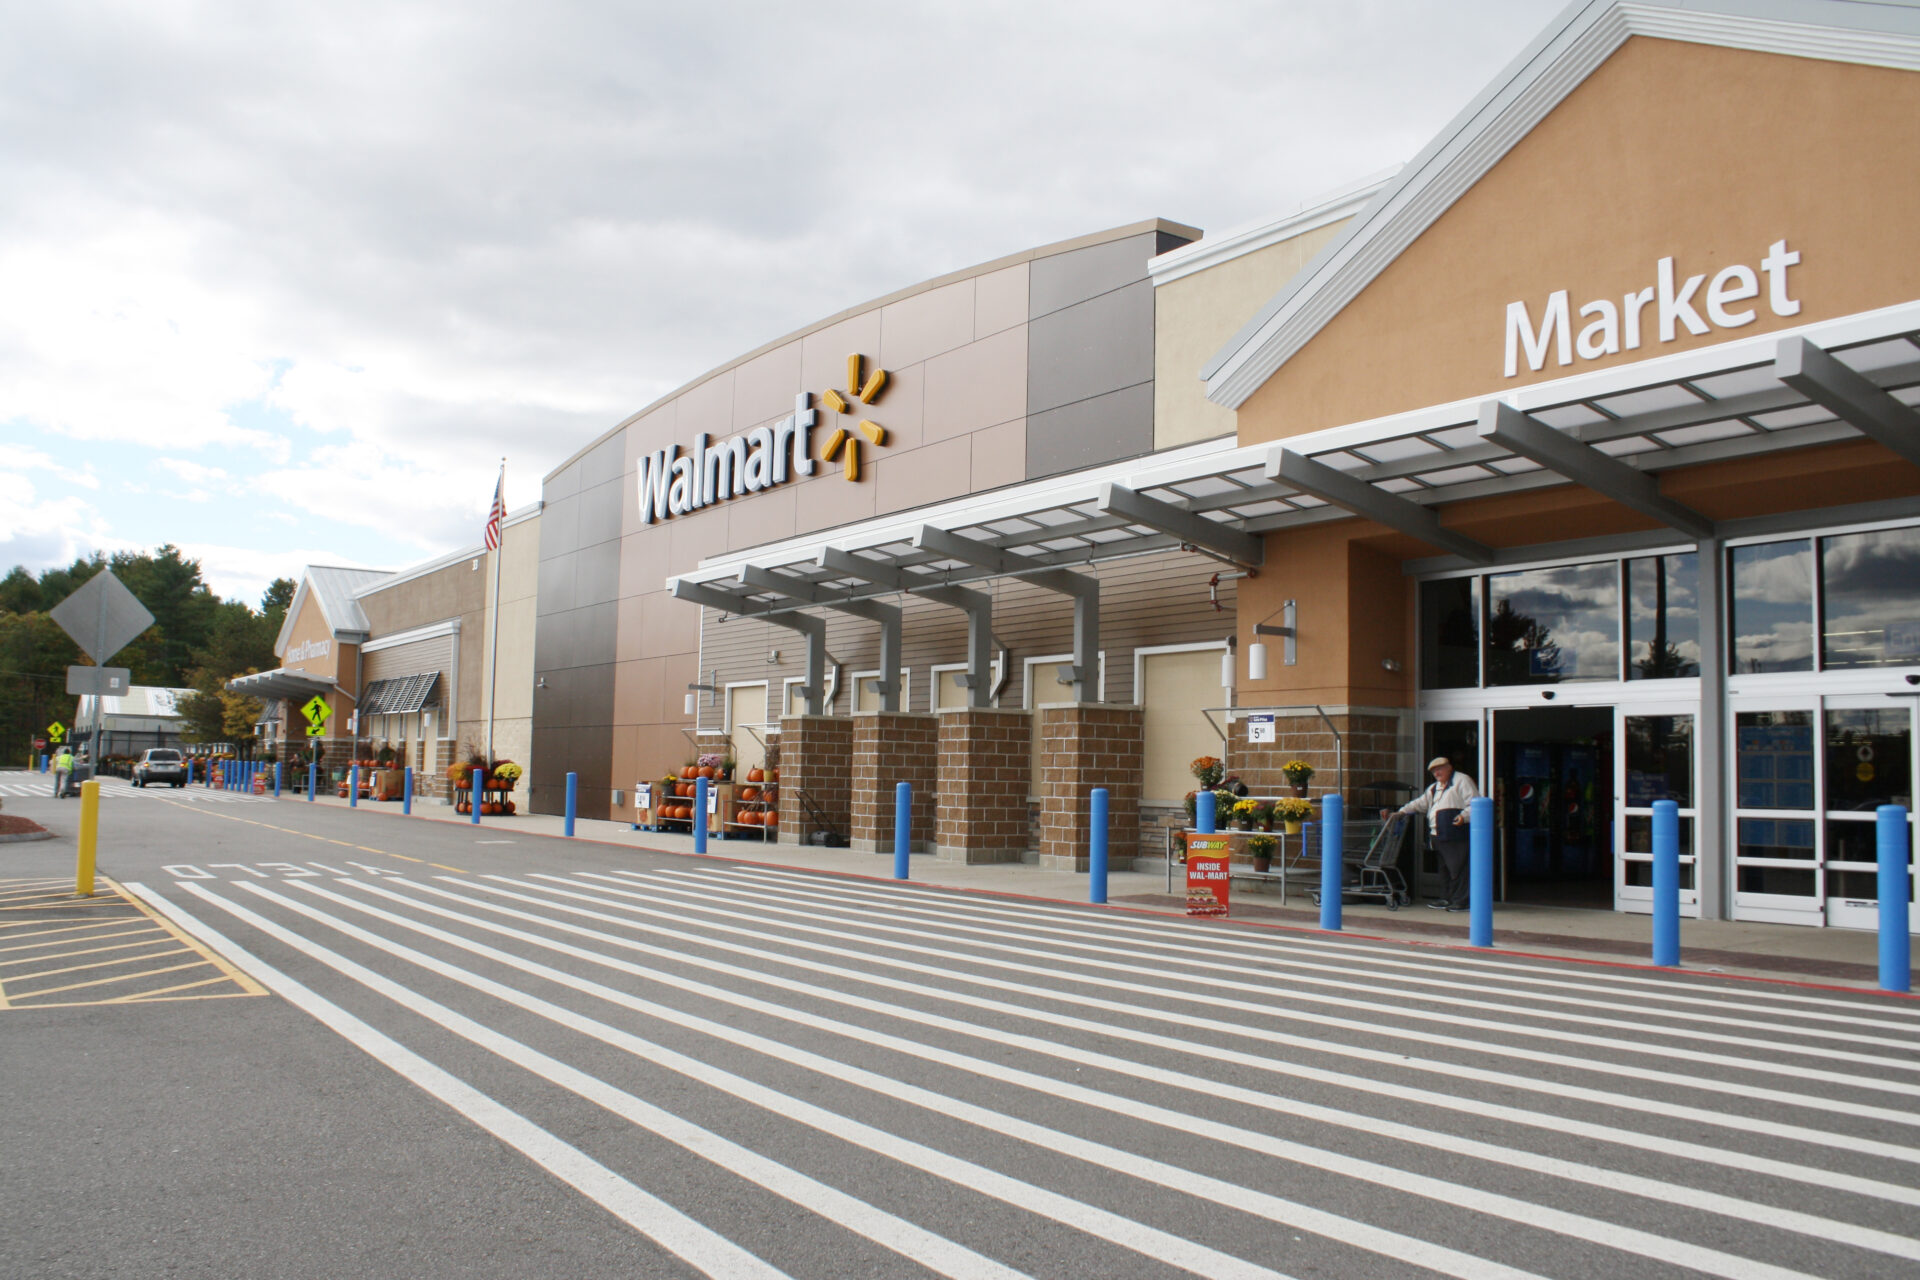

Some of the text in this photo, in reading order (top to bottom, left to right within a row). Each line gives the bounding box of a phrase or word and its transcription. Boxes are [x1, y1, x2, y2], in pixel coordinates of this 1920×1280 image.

[1503, 239, 1800, 379] Market
[637, 391, 817, 525] Walmart
[1190, 841, 1228, 849] SUBWAY
[1196, 862, 1221, 871] INSIDE
[1189, 871, 1228, 880] WAL-MART
